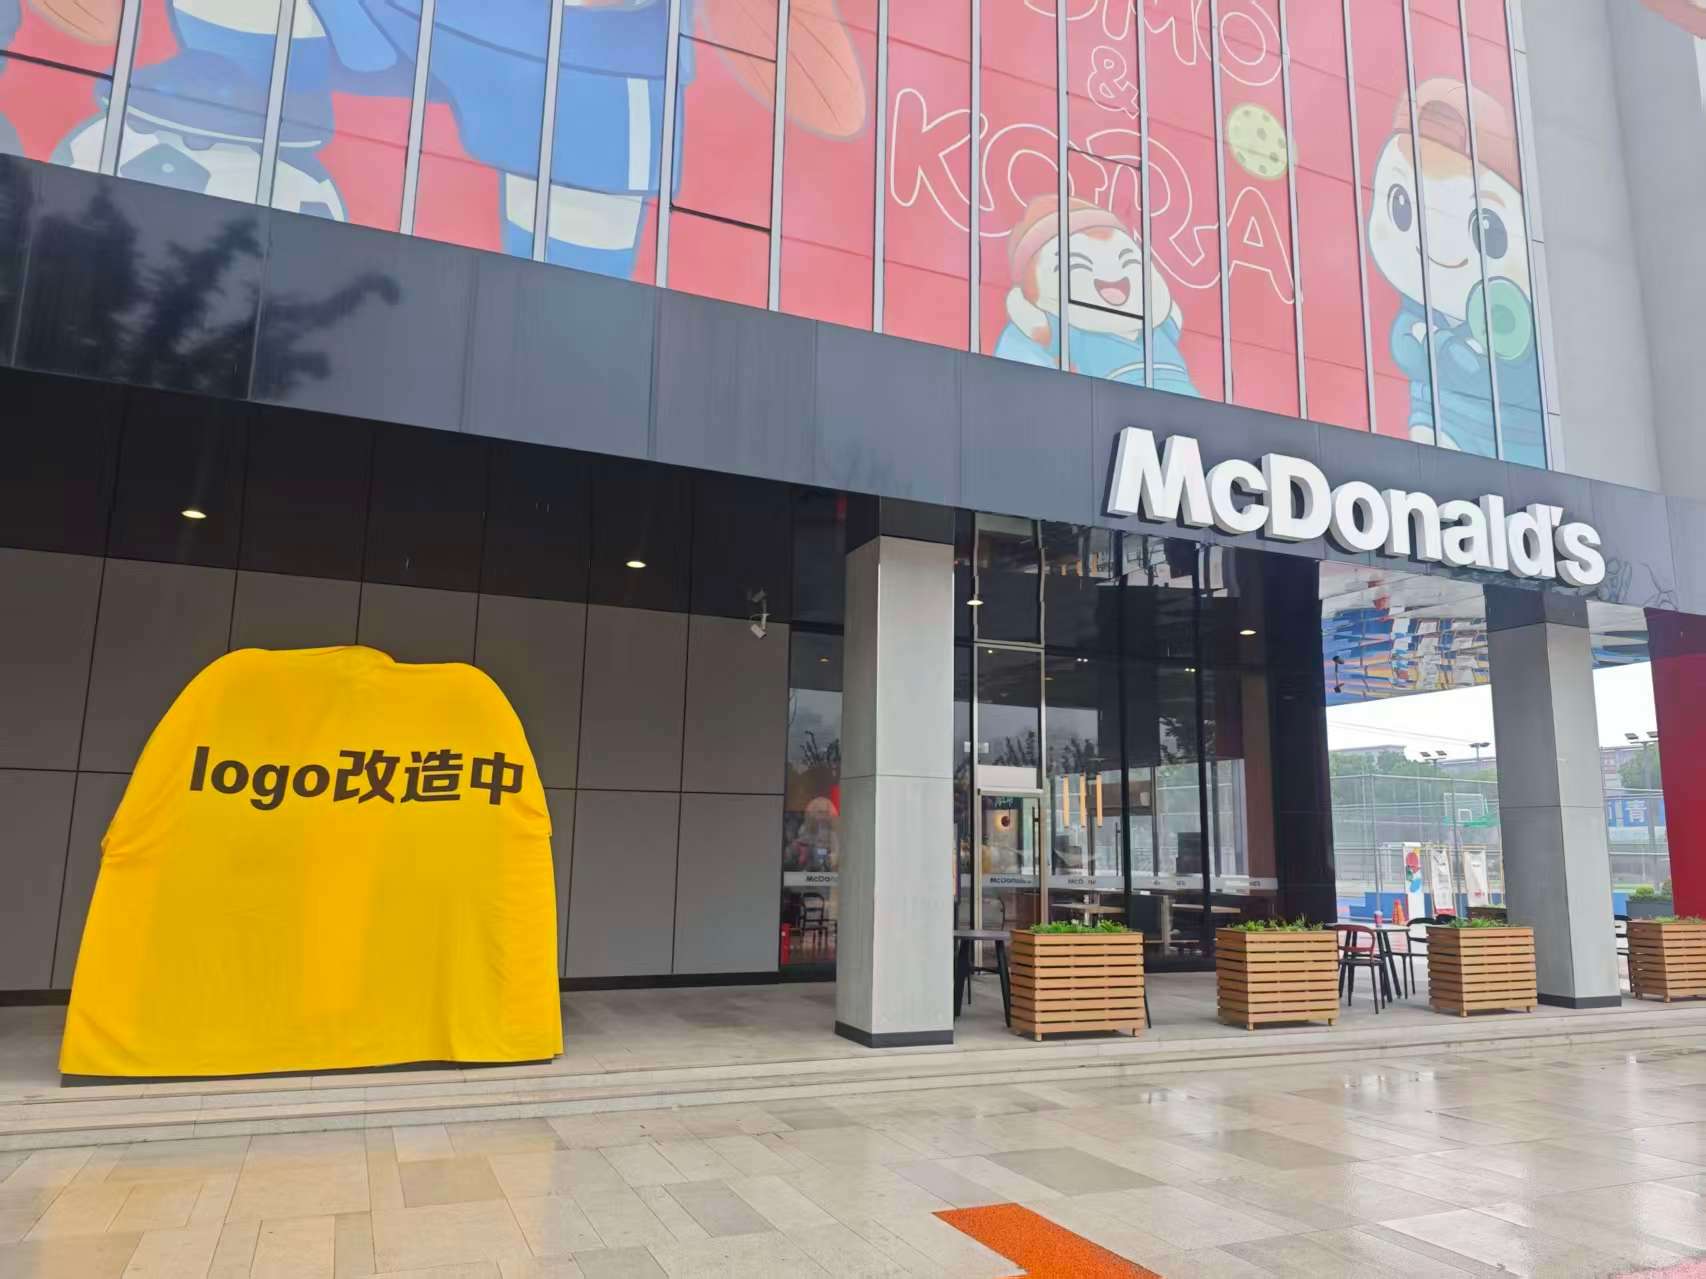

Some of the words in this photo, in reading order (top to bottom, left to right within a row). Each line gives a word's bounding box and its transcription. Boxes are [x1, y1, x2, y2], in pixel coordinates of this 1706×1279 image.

[1087, 45, 1140, 119] &
[1106, 426, 1606, 587] McDonald's
[189, 745, 524, 811] logo改造中
